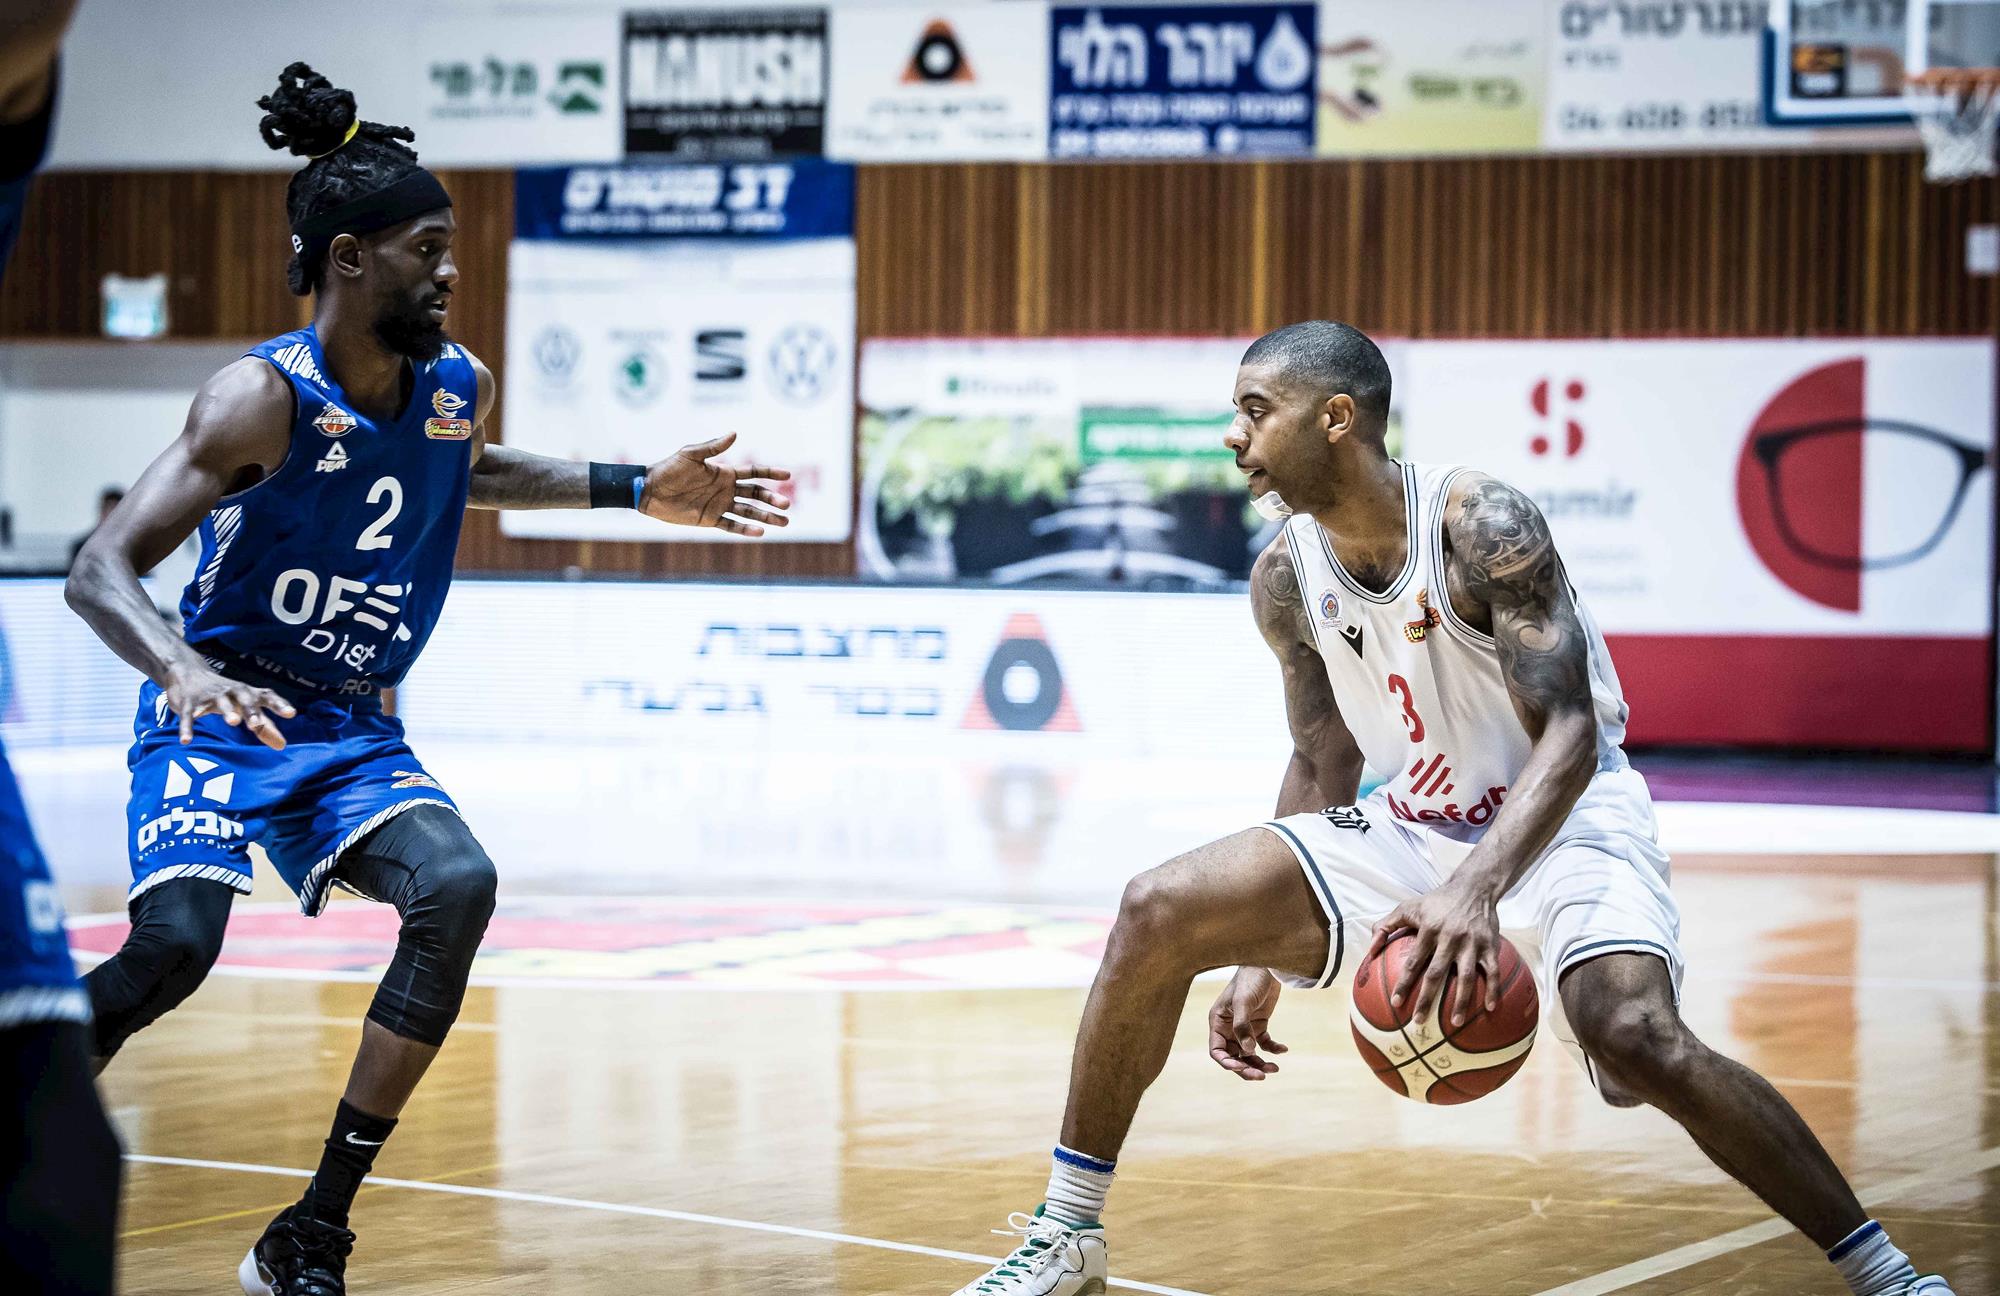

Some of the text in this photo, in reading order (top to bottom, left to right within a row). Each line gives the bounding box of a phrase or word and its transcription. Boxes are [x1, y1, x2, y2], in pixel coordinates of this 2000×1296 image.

[356, 476, 403, 550] 2
[1537, 478, 1638, 518] amir
[1388, 673, 1425, 743] 3
